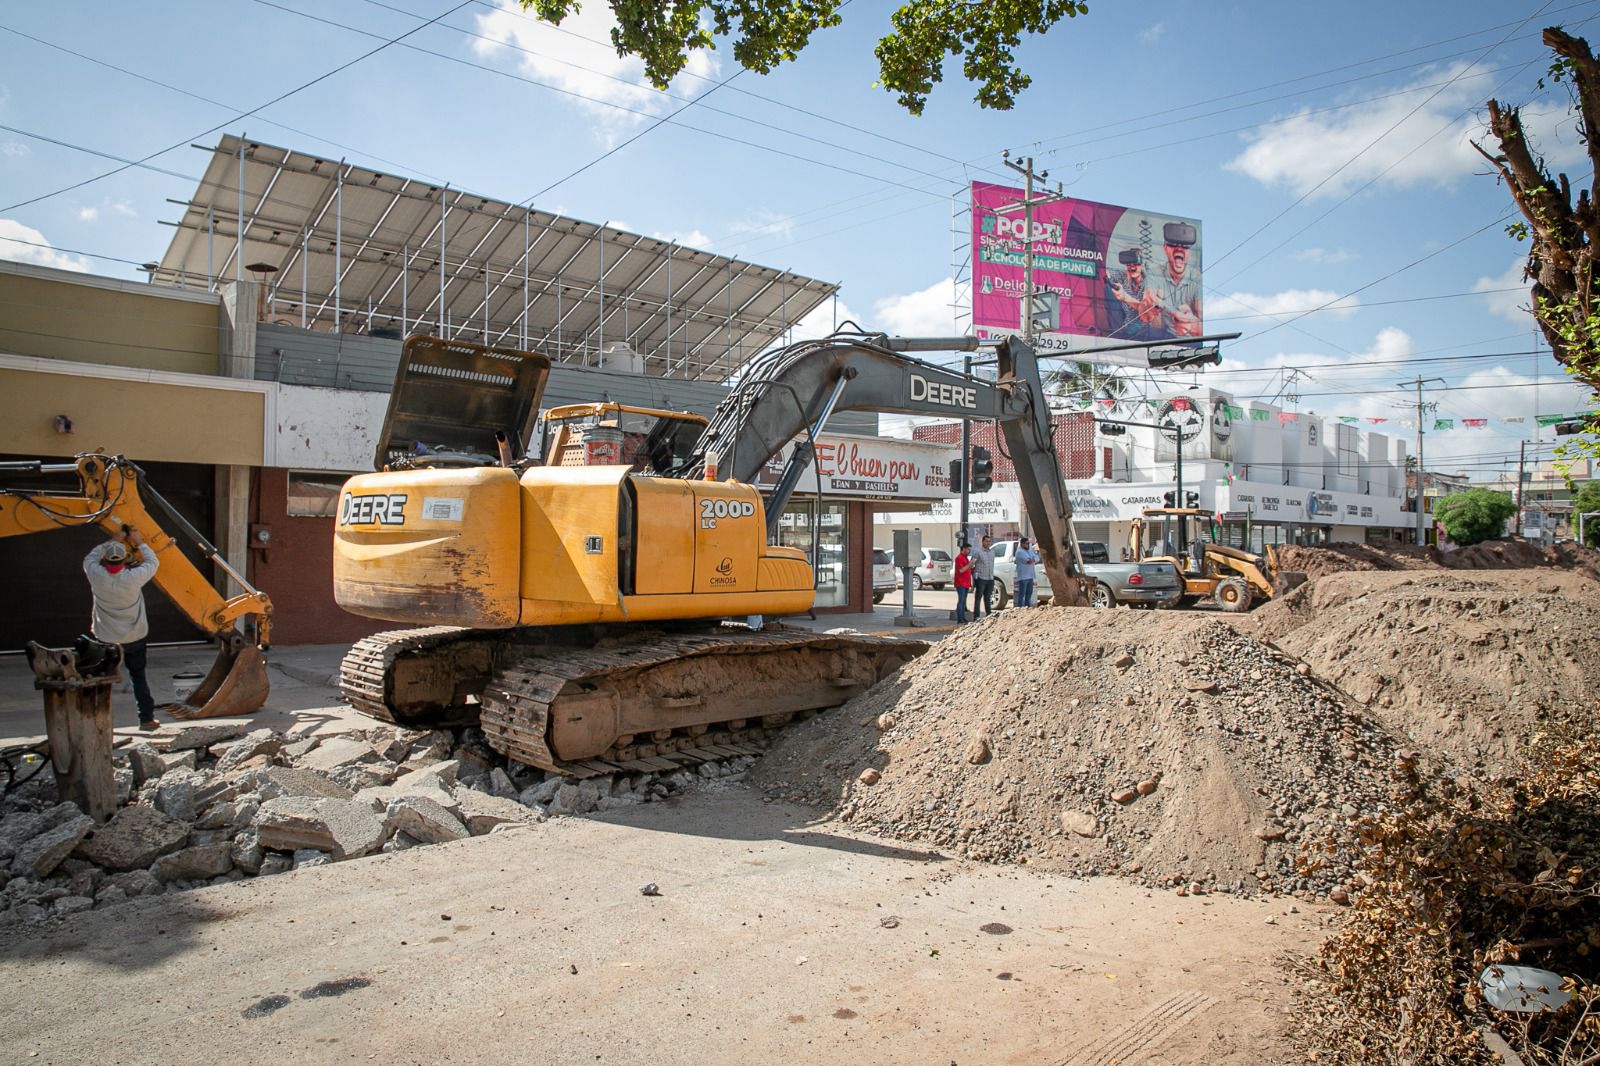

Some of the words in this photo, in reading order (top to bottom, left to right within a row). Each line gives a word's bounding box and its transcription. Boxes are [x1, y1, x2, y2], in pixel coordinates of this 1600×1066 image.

[1044, 244, 1103, 261] VANGUARDIA
[1047, 259, 1060, 270] DE
[1061, 261, 1093, 274] PUNTA
[910, 374, 976, 408] DEERE
[815, 442, 848, 476] El
[850, 443, 888, 480] buen
[889, 460, 921, 484] pan
[836, 480, 850, 489] PAN
[855, 481, 861, 489] Y
[968, 499, 1001, 508] ETINOPATÍA
[1121, 496, 1161, 504] CATARATAS
[341, 492, 407, 526] DEERE
[700, 499, 754, 519] 200D
[701, 518, 717, 529] LC
